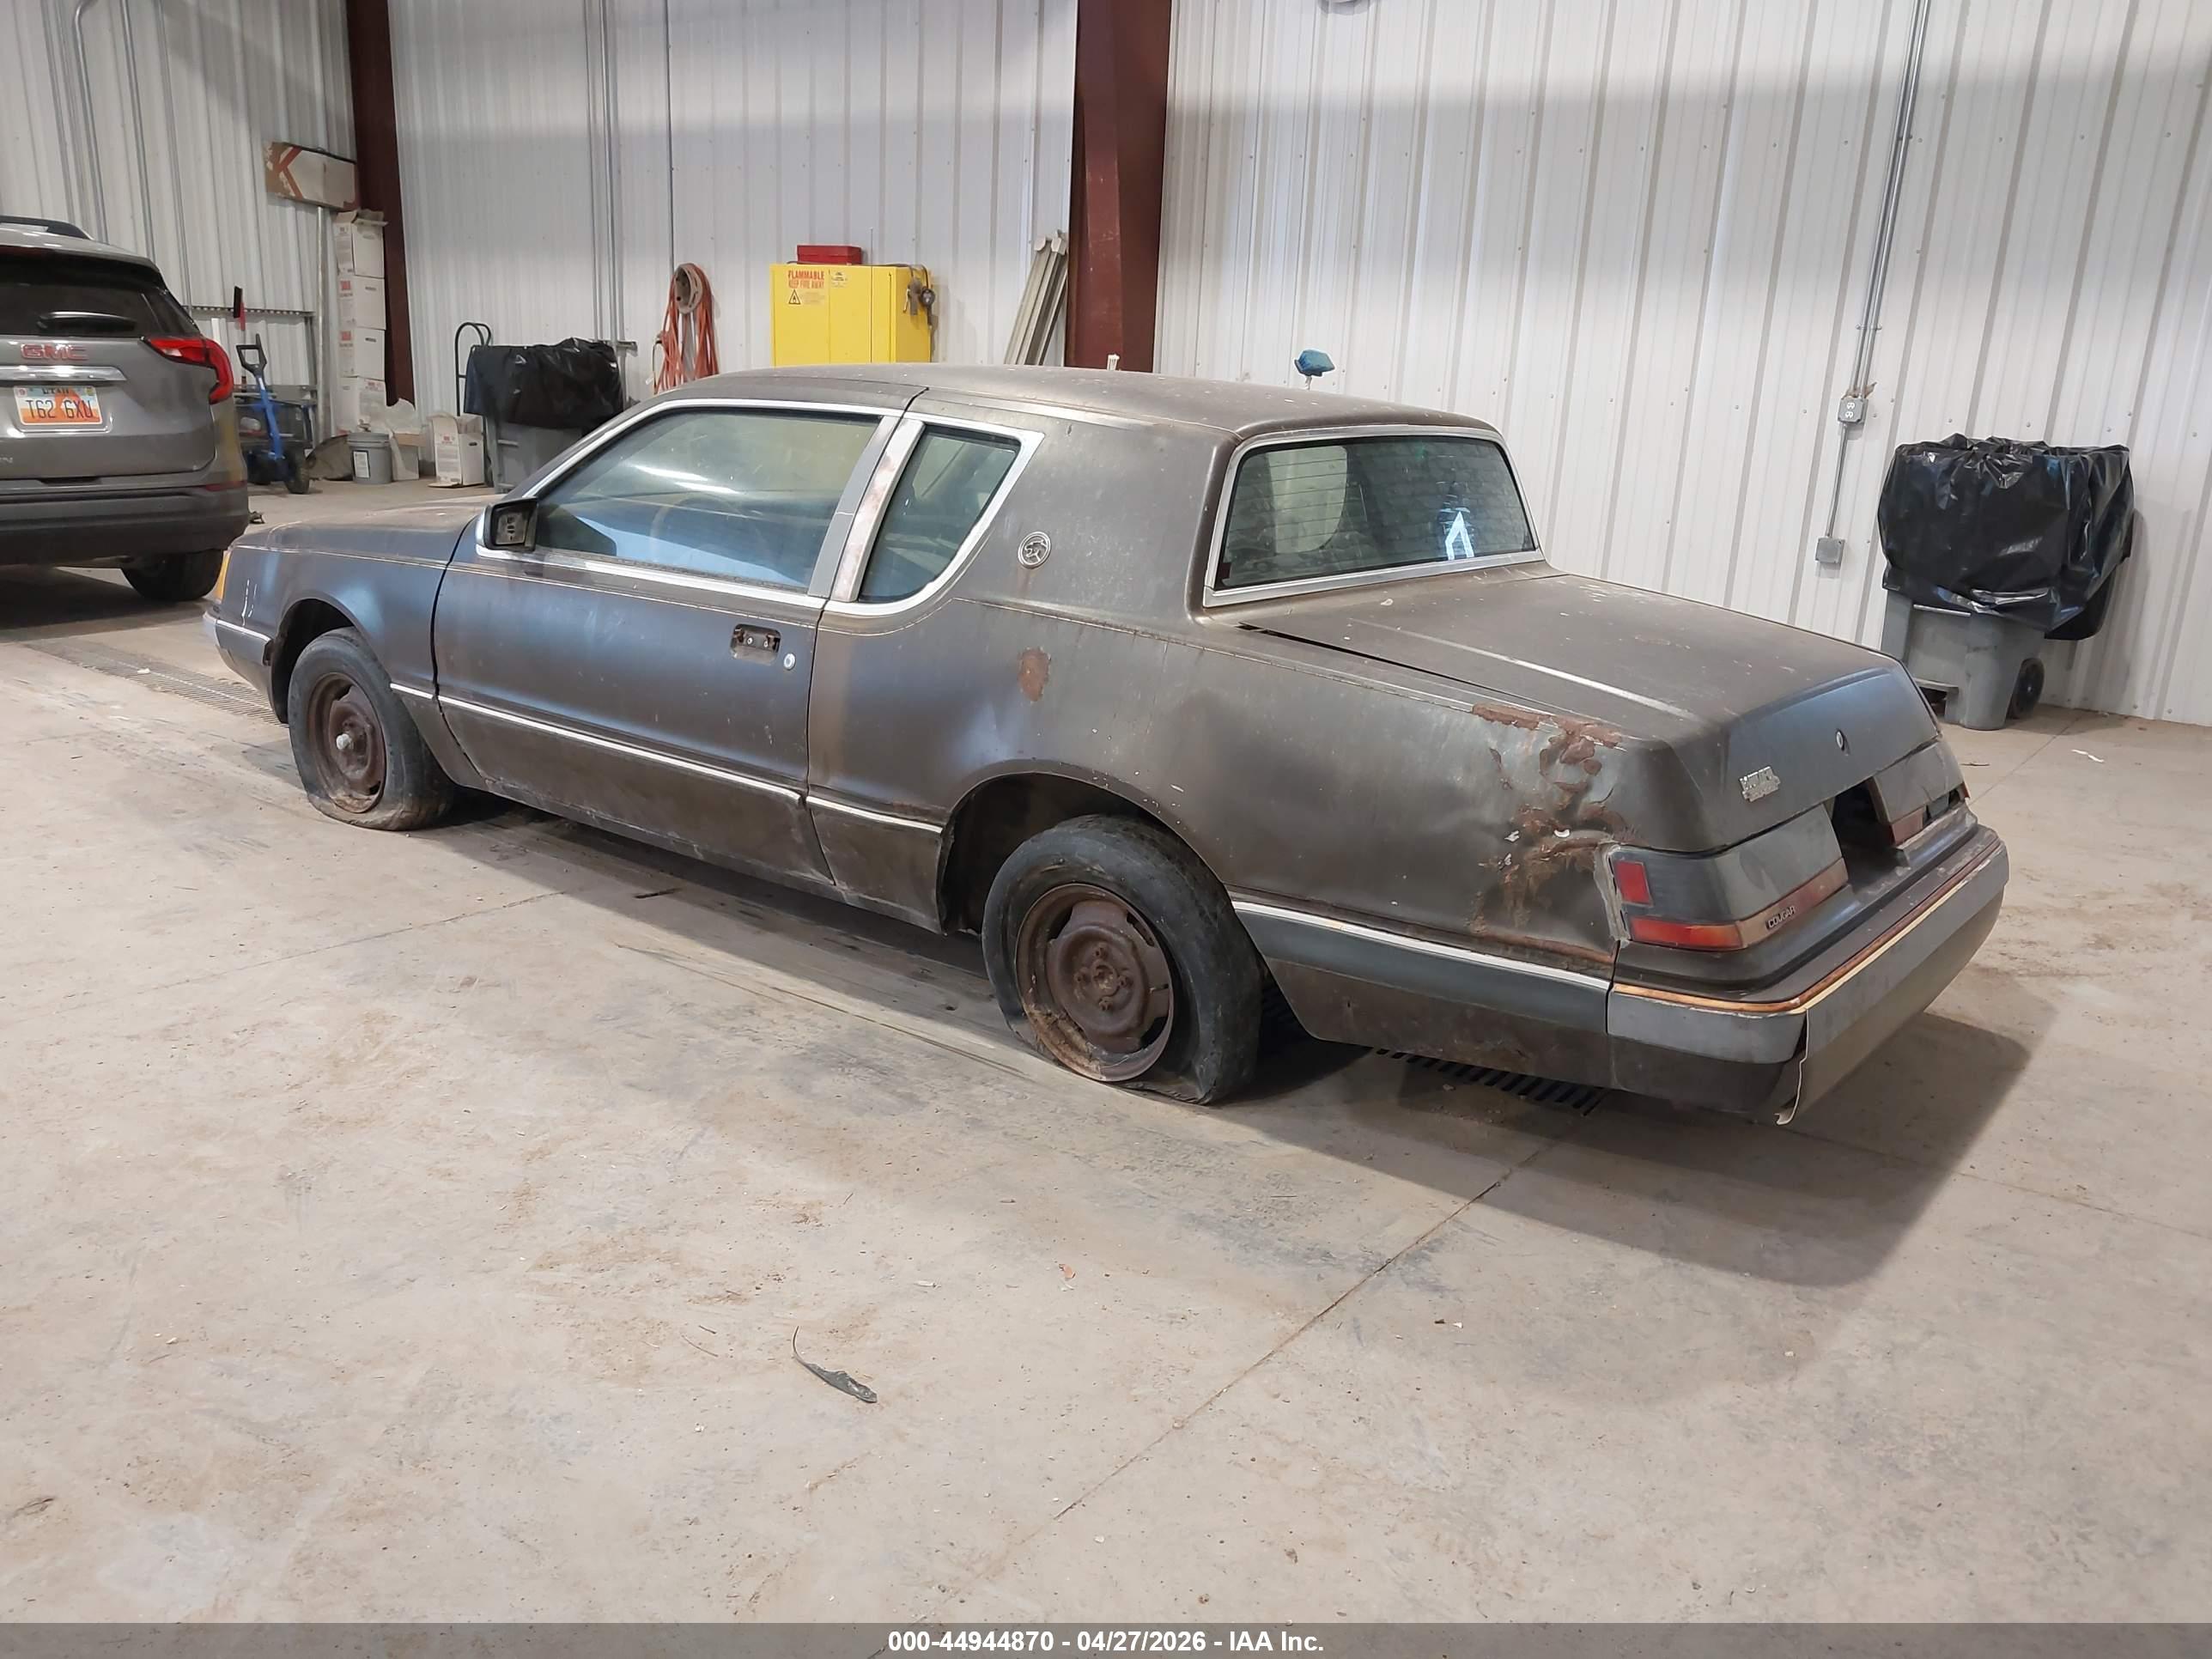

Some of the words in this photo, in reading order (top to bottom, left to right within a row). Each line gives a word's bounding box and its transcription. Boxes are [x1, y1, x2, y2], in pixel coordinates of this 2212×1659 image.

[787, 270, 824, 280] FLAMMABLE
[21, 343, 88, 361] GMC
[26, 399, 56, 419] T62
[1768, 906, 1796, 928] COUGAR
